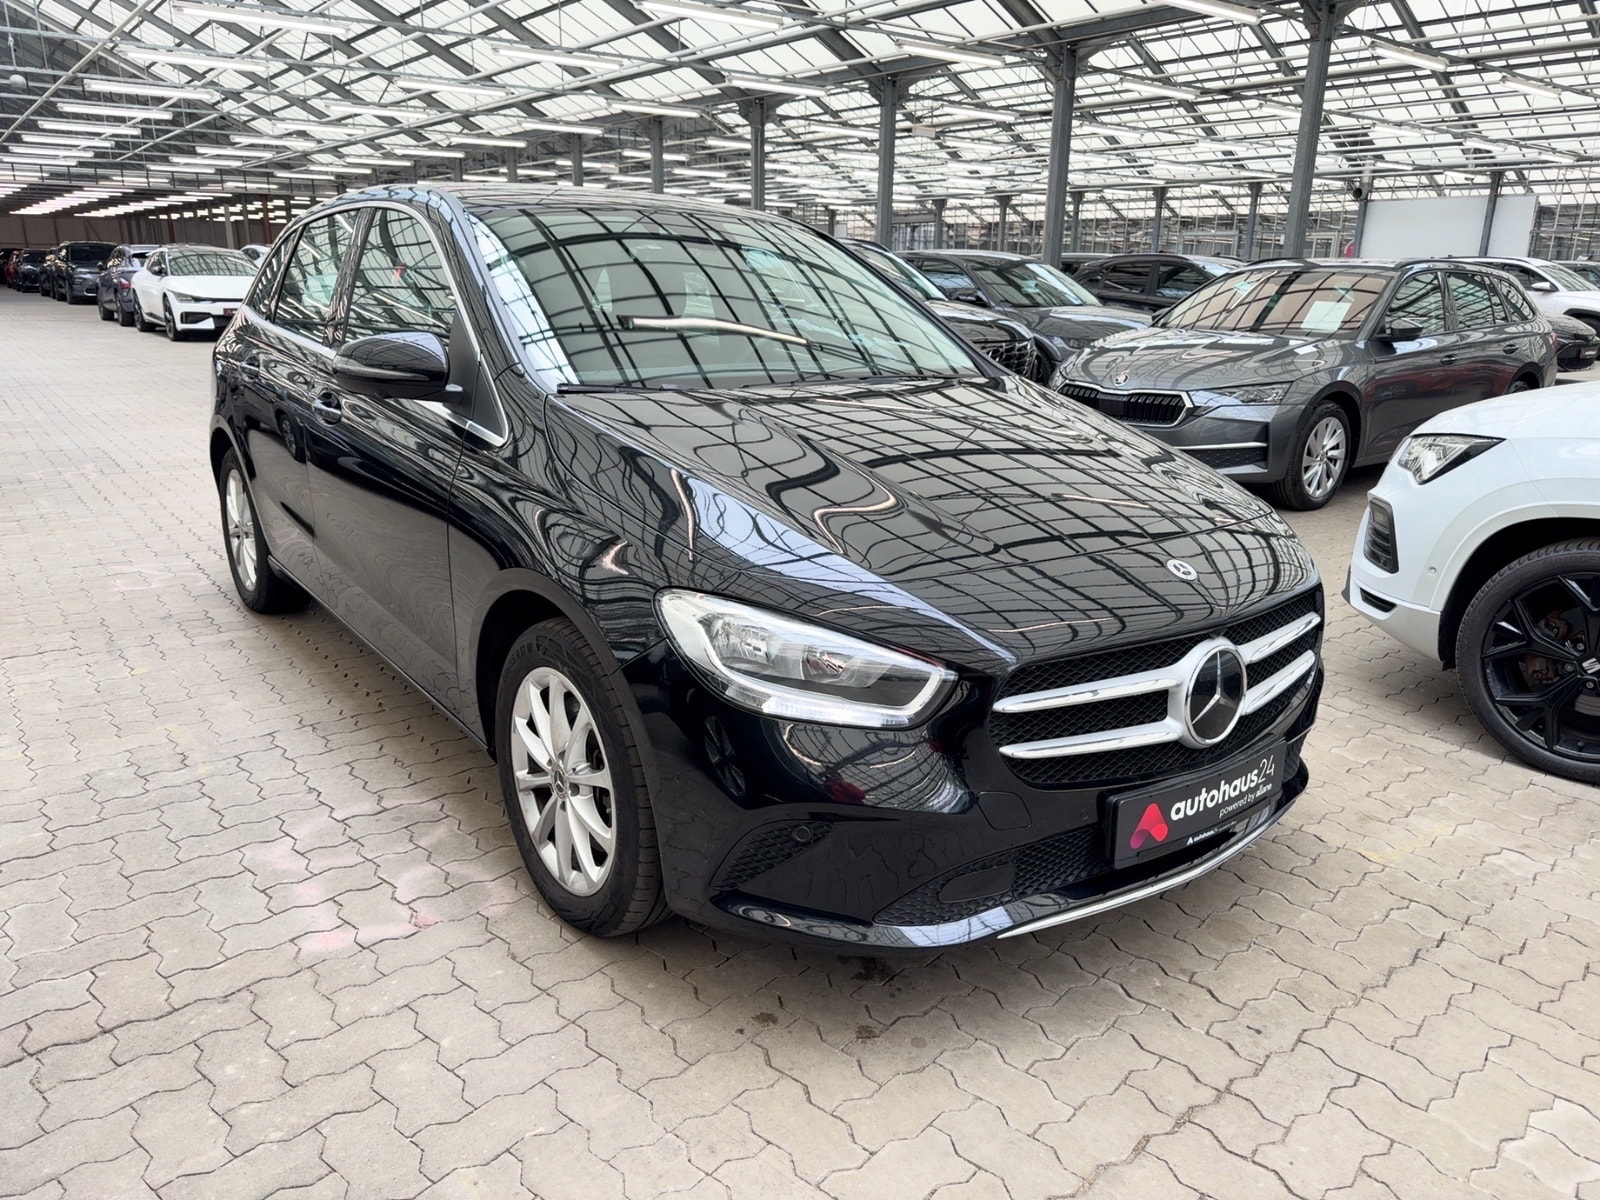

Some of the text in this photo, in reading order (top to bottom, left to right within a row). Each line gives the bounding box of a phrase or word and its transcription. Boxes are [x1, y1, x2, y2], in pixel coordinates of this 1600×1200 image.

[1170, 755, 1275, 821] autohaus24
[1219, 794, 1248, 818] powered
[1247, 792, 1256, 803] by
